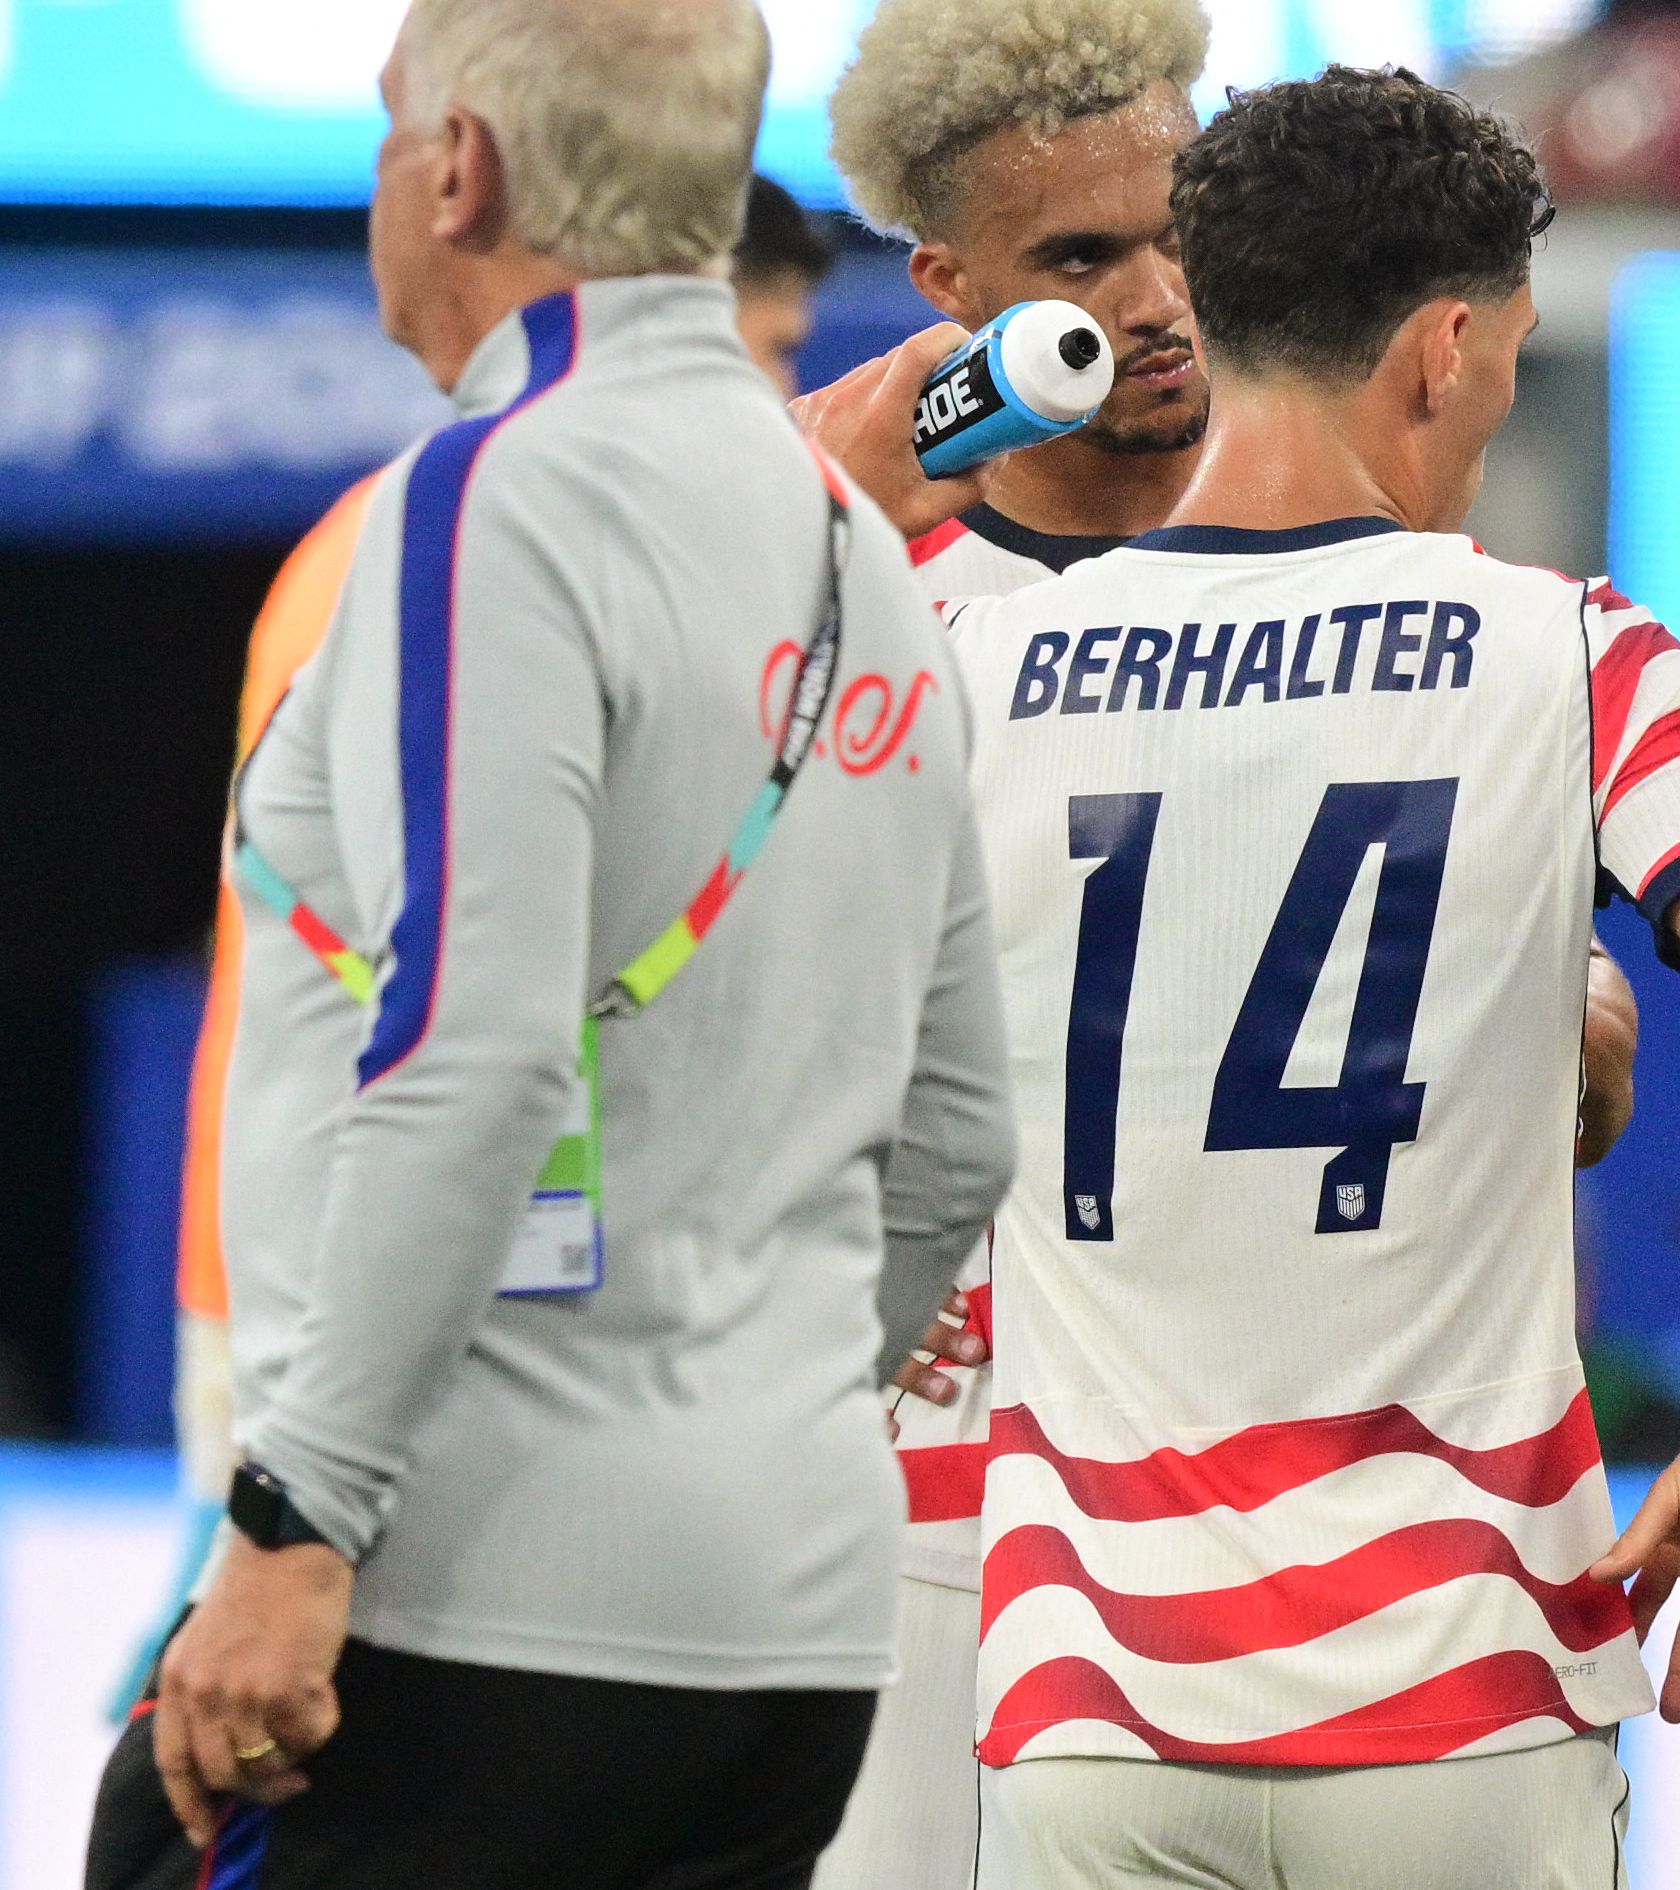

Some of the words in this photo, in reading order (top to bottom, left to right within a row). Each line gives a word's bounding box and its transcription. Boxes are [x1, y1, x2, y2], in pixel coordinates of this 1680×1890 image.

[1008, 600, 1481, 721] BERHALTER
[1064, 776, 1460, 1241] 14
[1076, 1197, 1096, 1211] USA
[1339, 1186, 1362, 1200] USA
